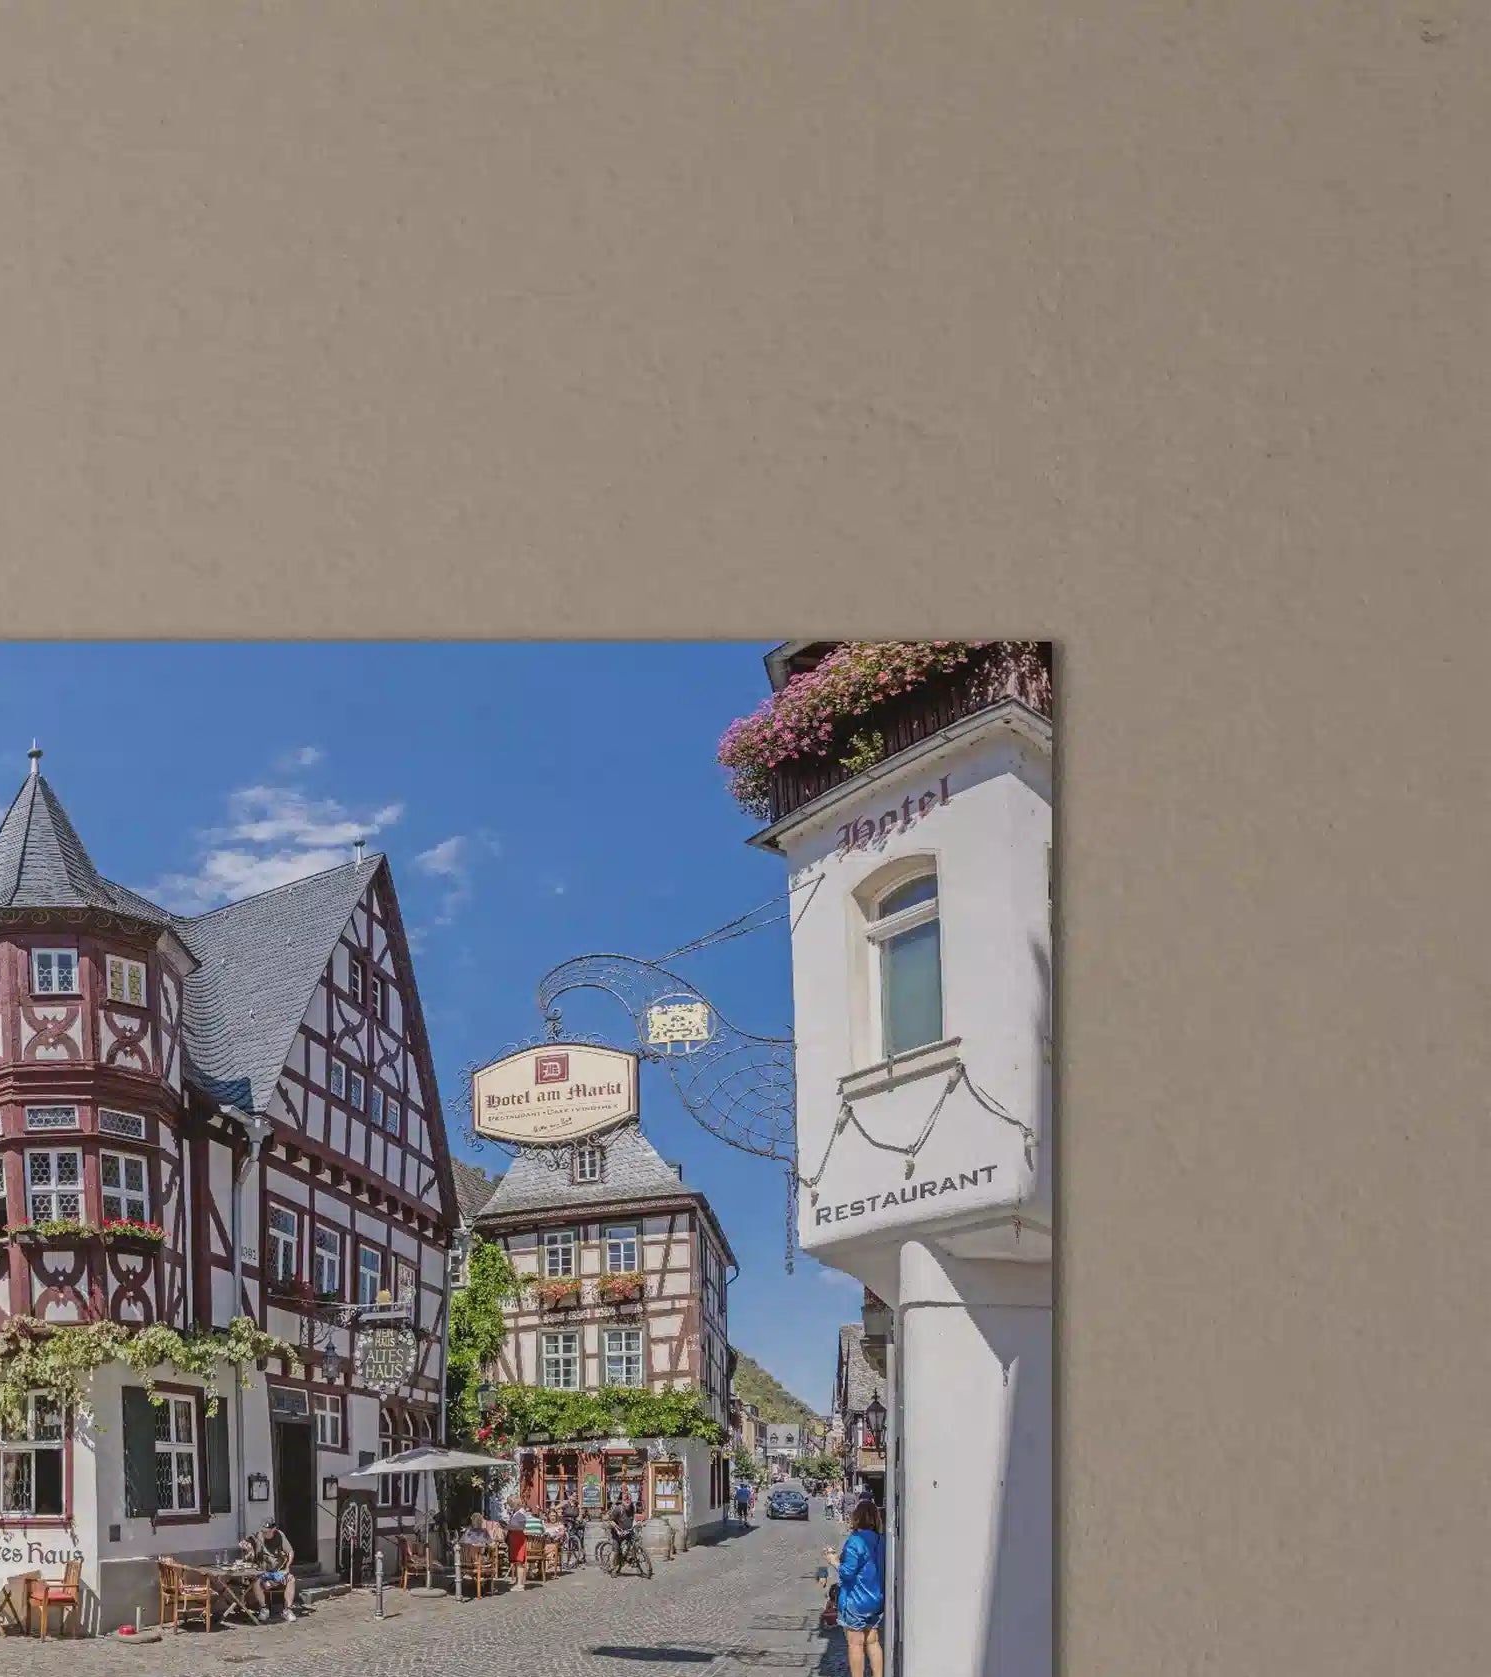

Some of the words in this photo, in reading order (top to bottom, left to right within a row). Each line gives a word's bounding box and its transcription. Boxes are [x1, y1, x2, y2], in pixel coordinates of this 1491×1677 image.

[835, 773, 951, 863] Hotel
[484, 1090, 530, 1110] Hotel
[537, 1090, 560, 1102] am
[566, 1081, 621, 1100] Markt
[815, 1165, 998, 1227] RESTAURANT
[374, 1337, 396, 1347] HAUS
[364, 1348, 404, 1363] ALTES
[365, 1363, 404, 1378] HAUS
[27, 1541, 84, 1565] Haus
